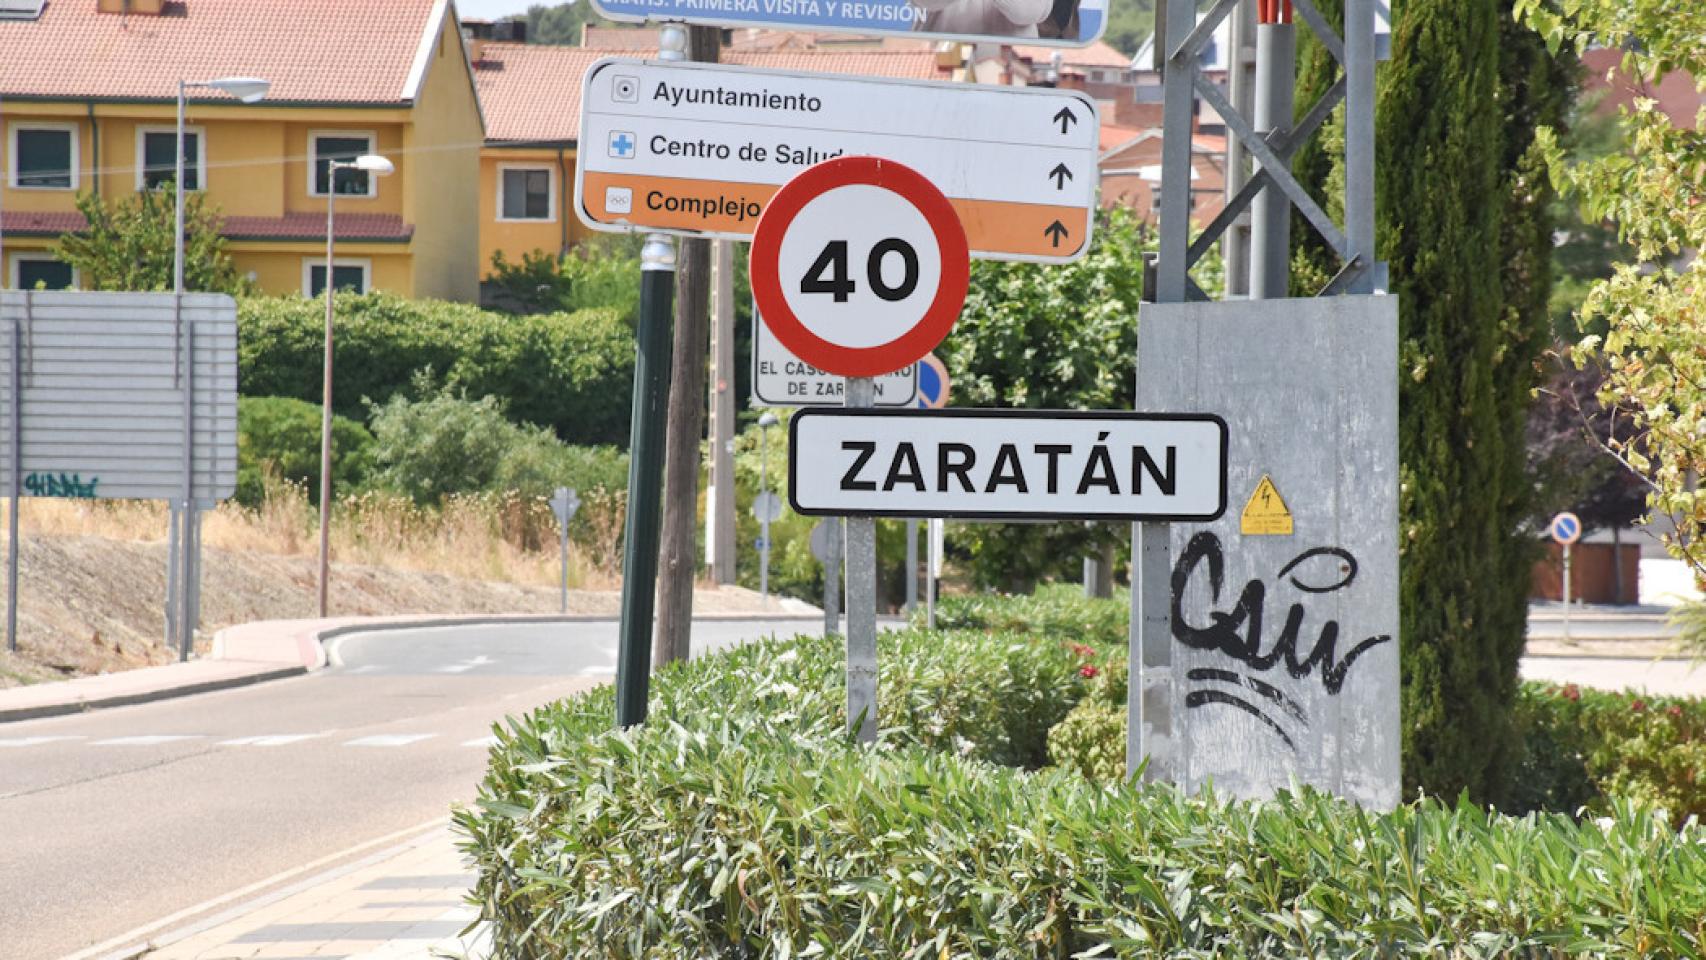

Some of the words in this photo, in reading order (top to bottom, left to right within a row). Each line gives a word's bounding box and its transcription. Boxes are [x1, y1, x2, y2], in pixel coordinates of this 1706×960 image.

[764, 0, 820, 16] VISITA
[826, 2, 837, 17] Y
[841, 2, 927, 22] REVISIÓN
[653, 81, 821, 112] Ayuntamiento
[650, 135, 730, 160] Centro
[738, 142, 767, 162] de
[647, 191, 761, 221] Complejo
[800, 237, 919, 303] 40
[759, 361, 777, 375] EL
[787, 381, 808, 396] DE
[840, 432, 1177, 496] ZARATÁN
